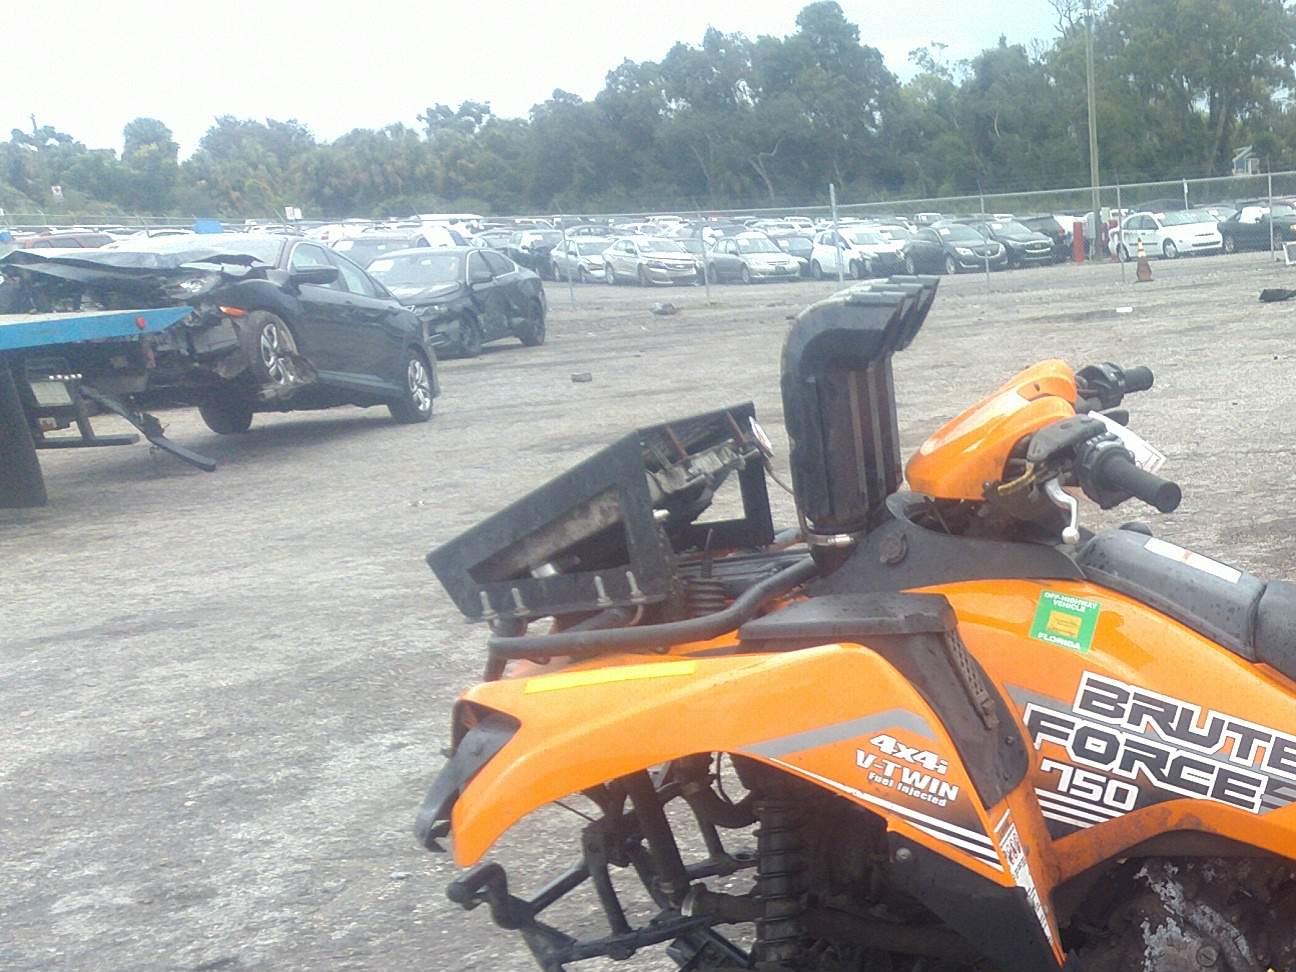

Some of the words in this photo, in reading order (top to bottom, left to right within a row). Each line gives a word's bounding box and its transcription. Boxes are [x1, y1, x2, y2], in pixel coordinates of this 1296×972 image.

[1053, 600, 1086, 613] VEHICLE
[1037, 632, 1081, 651] FLORIDA
[855, 749, 960, 801] V-TWIN
[1023, 702, 1270, 815] FORCE
[1040, 758, 1140, 812] 750
